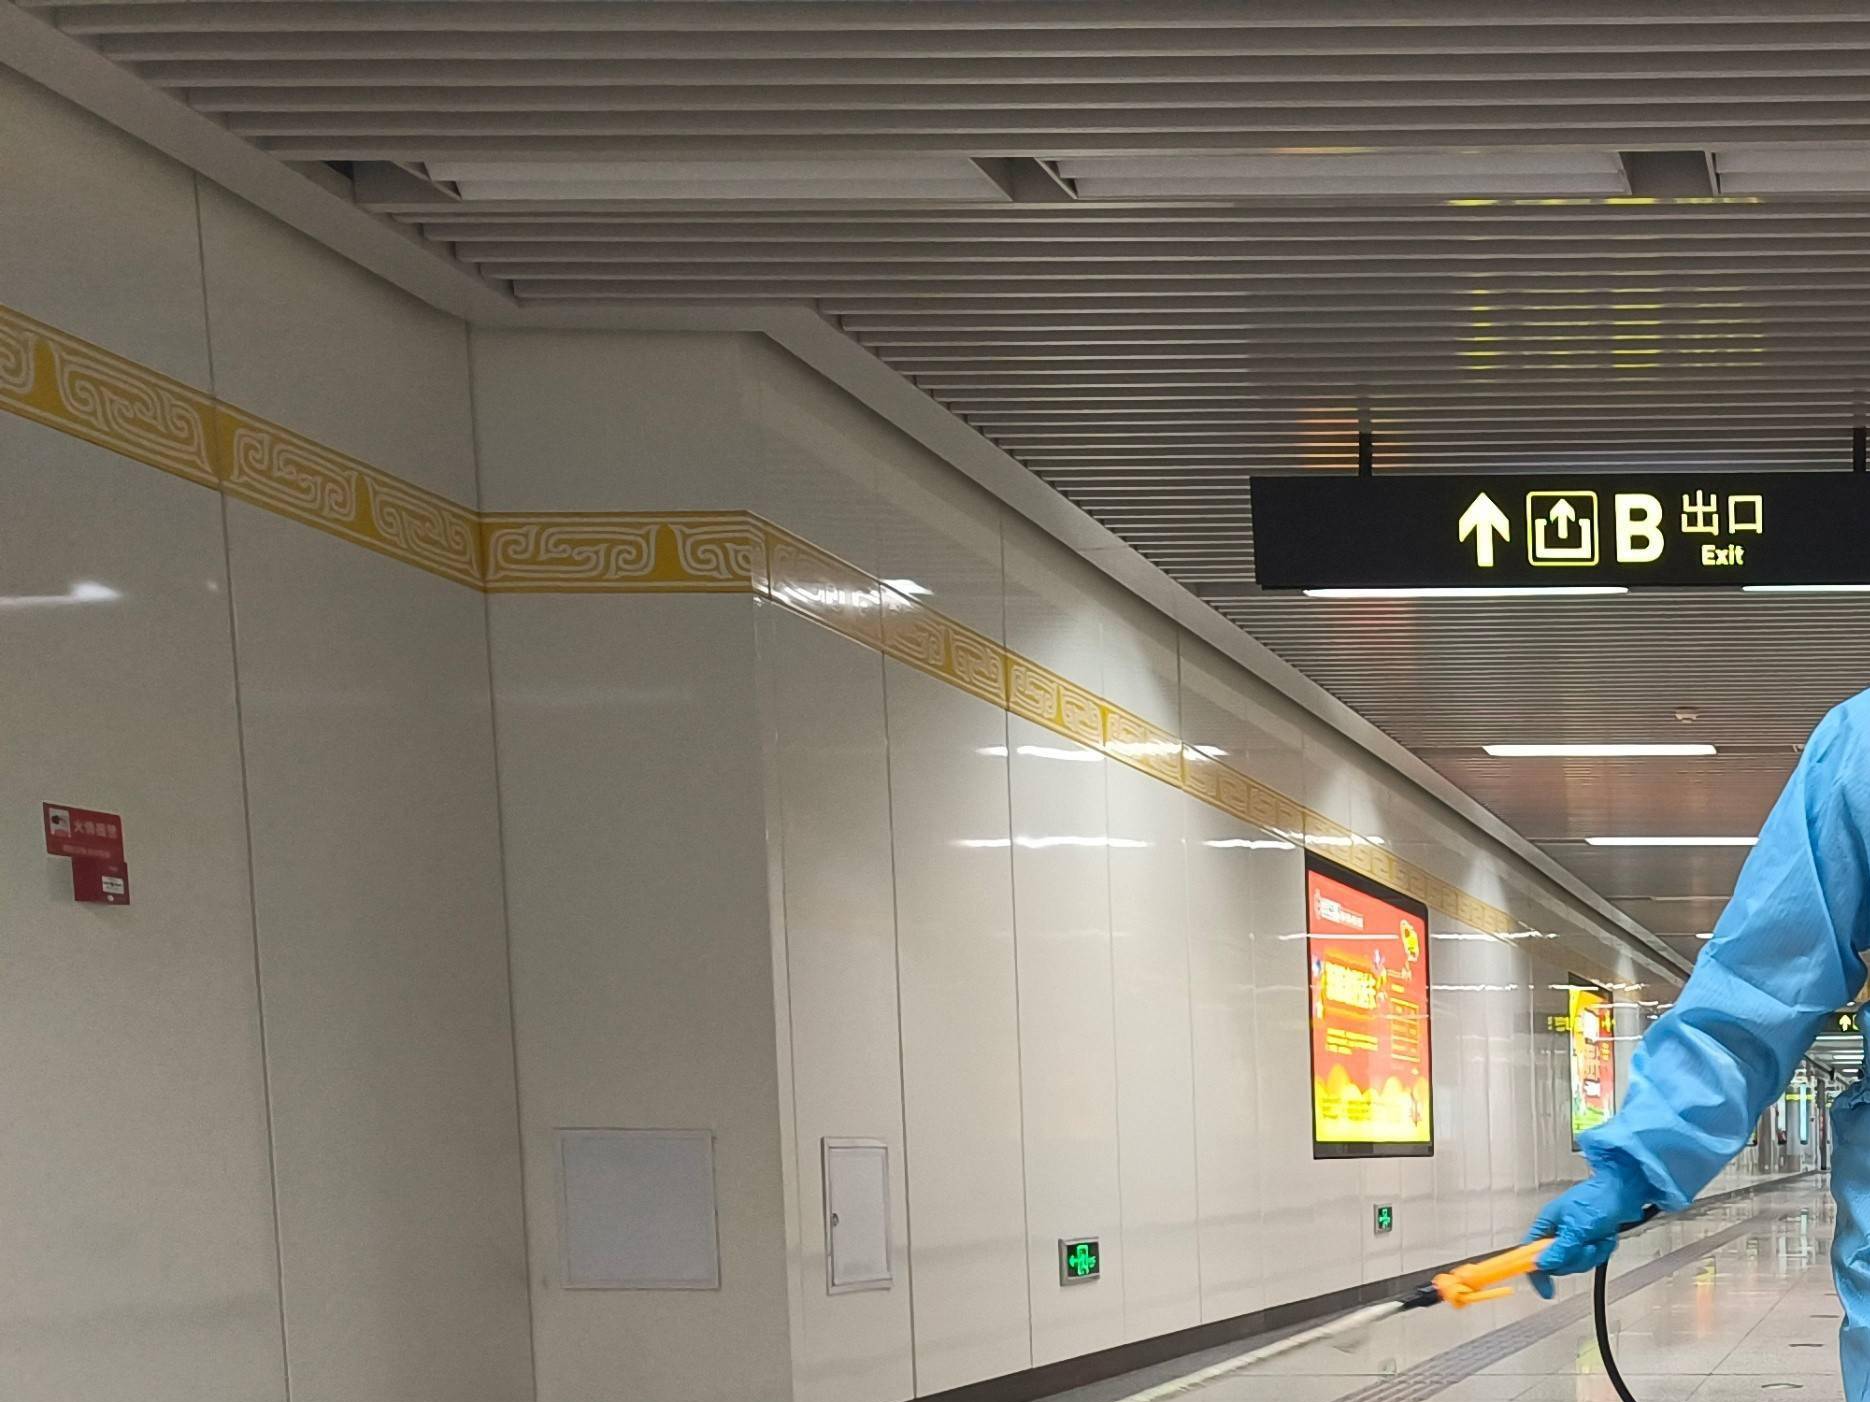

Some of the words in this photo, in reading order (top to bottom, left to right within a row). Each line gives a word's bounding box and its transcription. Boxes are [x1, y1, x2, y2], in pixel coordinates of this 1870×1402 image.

[1614, 493, 1665, 563] B
[1680, 489, 1763, 537] 出口
[1701, 543, 1745, 566] Exit
